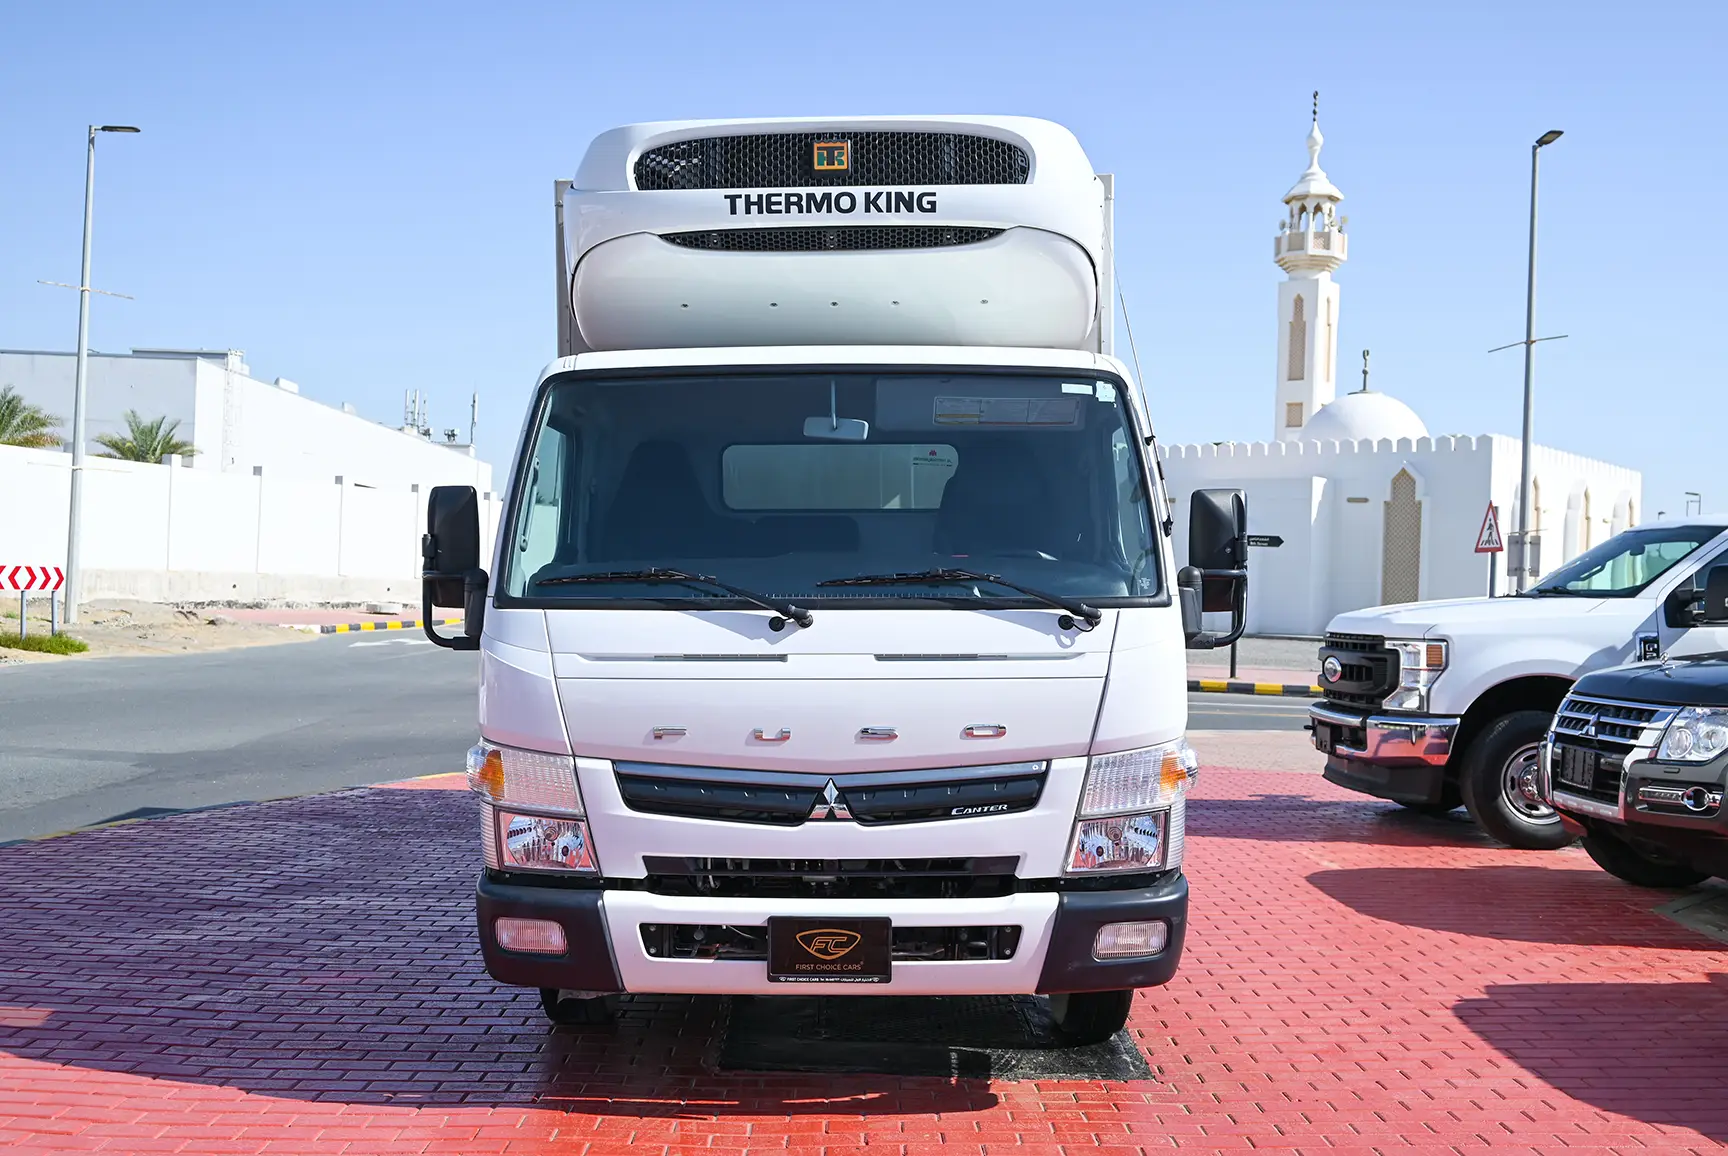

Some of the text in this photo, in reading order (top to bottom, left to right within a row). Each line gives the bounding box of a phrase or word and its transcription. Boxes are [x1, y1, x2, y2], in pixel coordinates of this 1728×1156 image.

[723, 191, 937, 215] THERMO KING
[652, 724, 1007, 742] FUSO
[795, 963, 861, 971] FIRST CHOICE CARS
